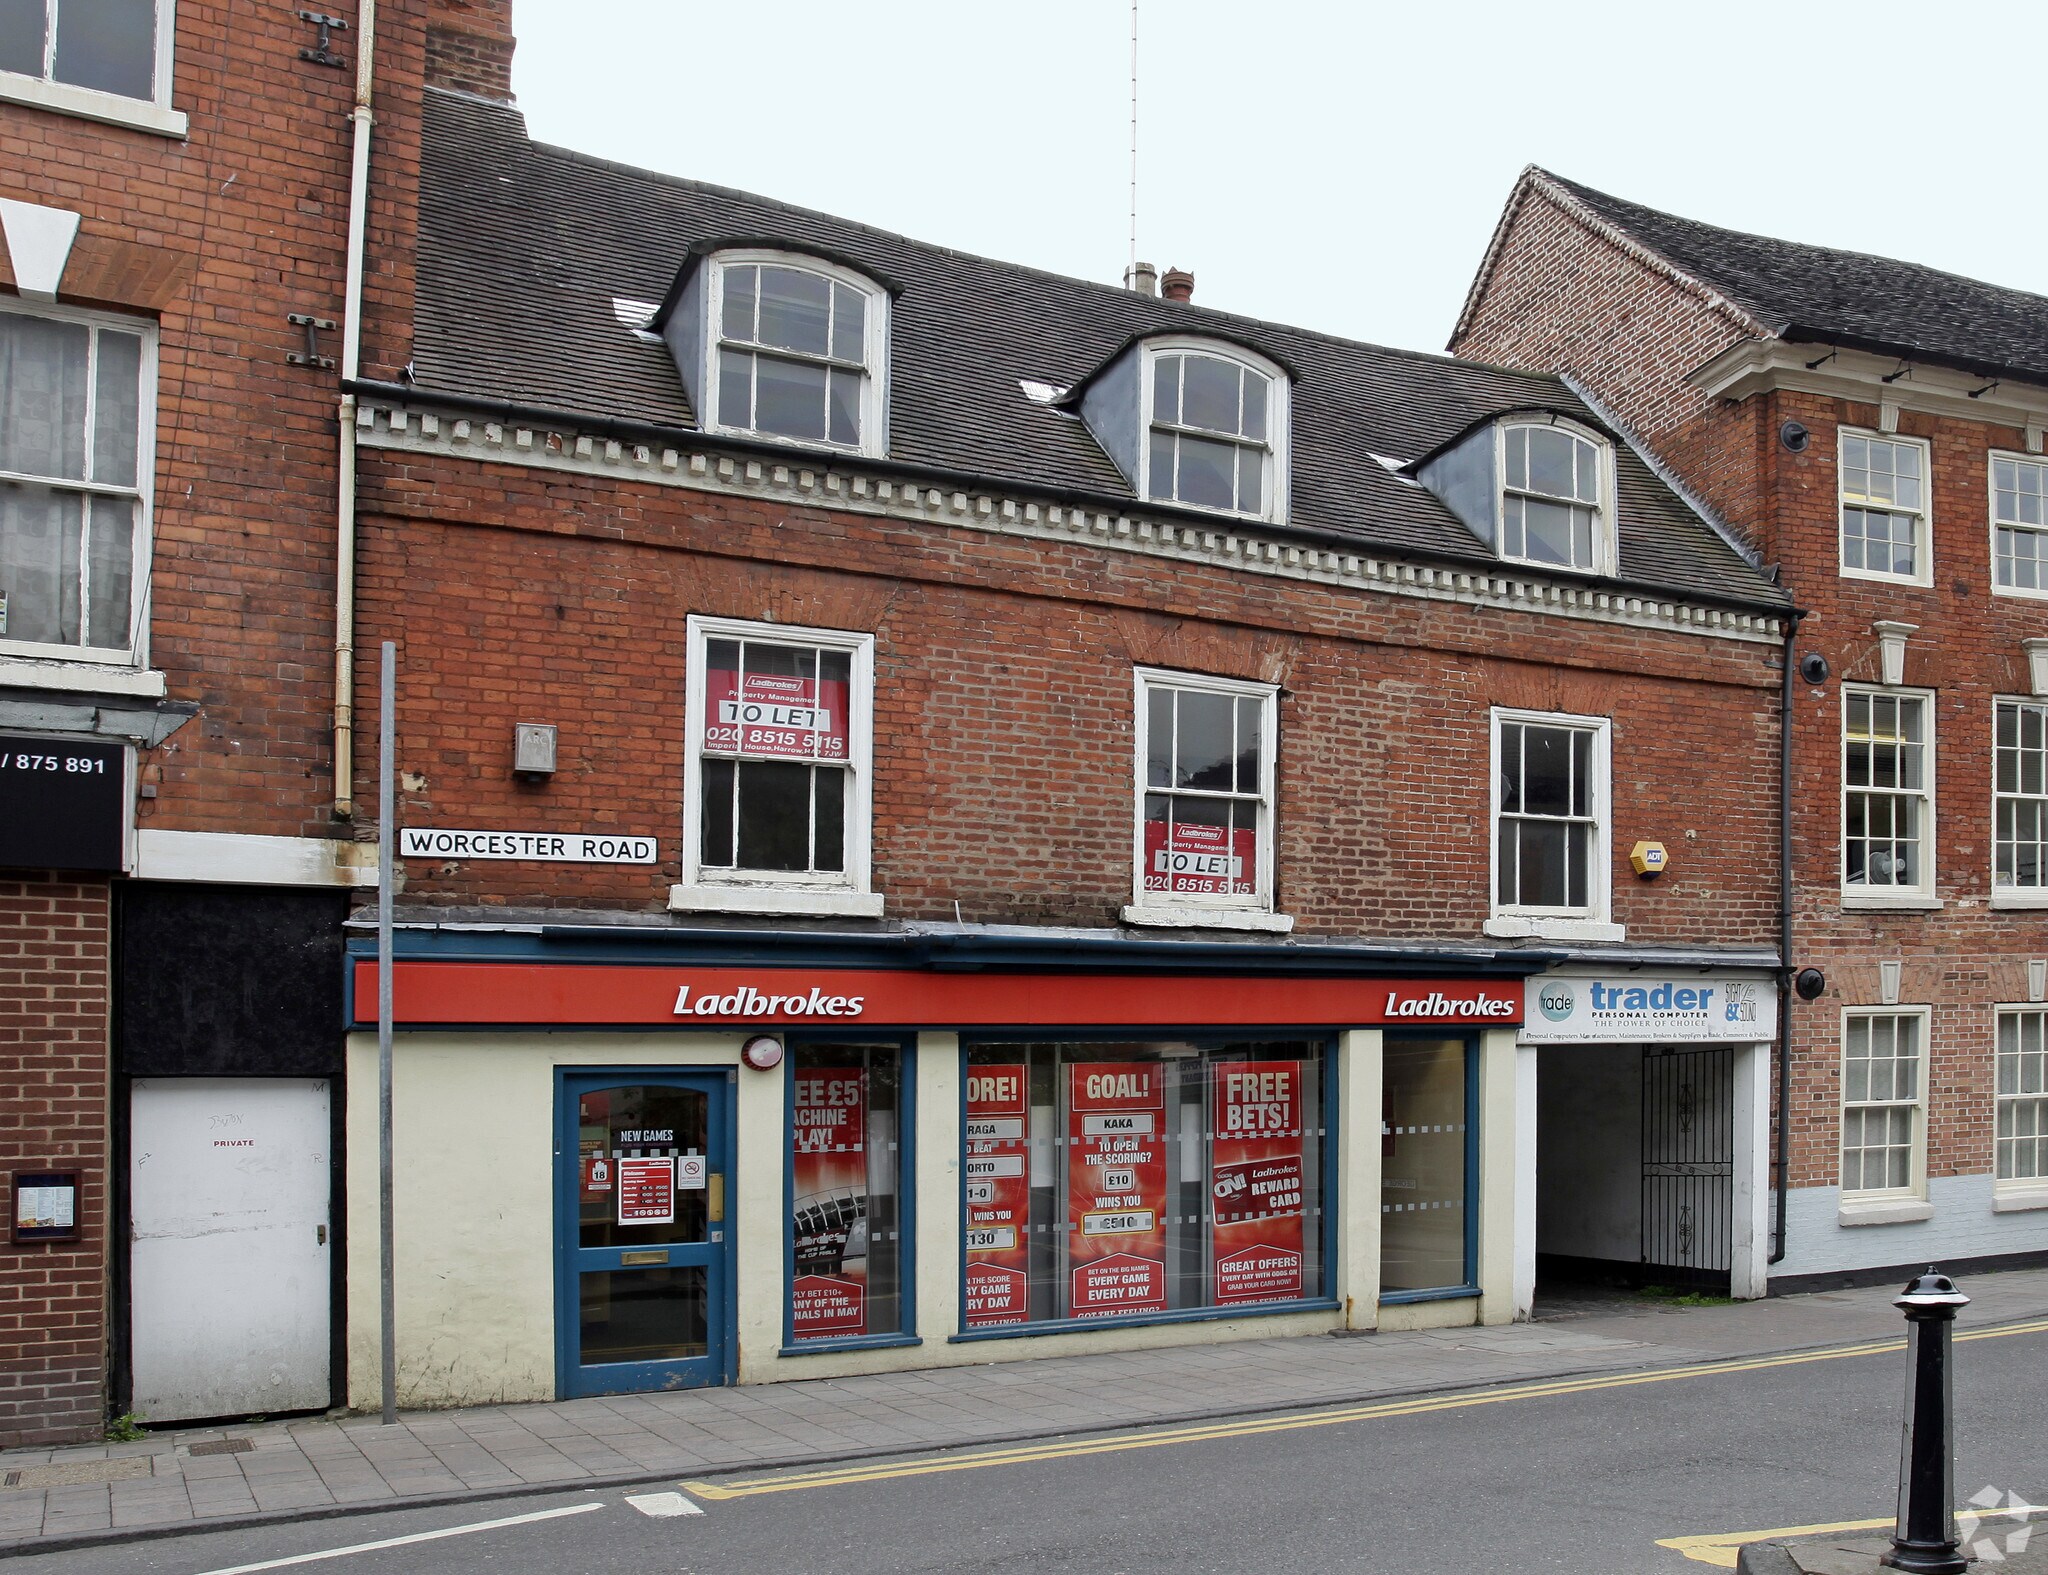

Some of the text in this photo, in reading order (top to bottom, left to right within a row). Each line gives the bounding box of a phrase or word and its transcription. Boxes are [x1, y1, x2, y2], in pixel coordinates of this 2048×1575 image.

[751, 679, 798, 690] Ladbrokes
[728, 690, 765, 700] Prperty
[728, 704, 822, 727] TO LET
[749, 729, 796, 746] 8515
[16, 754, 58, 771] 875
[65, 757, 104, 774] 891
[1181, 829, 1219, 839] Ladbrokes
[409, 832, 650, 860] WORCESTER ROAD
[1163, 839, 1193, 850] Poperty
[1647, 852, 1662, 861] ADT
[1162, 853, 1235, 874] TO LET
[1176, 878, 1213, 892] 8515
[1218, 881, 1250, 894] 515
[672, 985, 865, 1017] Ladbrokes
[1590, 982, 1714, 1010] trader
[1384, 992, 1515, 1016] Ladbrokes
[1725, 1003, 1741, 1022] &
[1654, 1020, 1668, 1028] OF
[967, 1077, 1017, 1102] ORE!
[1086, 1074, 1149, 1099] GOAL!
[1227, 1072, 1290, 1103] FREE
[795, 1080, 859, 1107] EE £5
[1227, 1102, 1289, 1130] BETS!
[967, 1125, 996, 1135] RAGA
[1104, 1119, 1133, 1128] KAKA
[621, 1129, 673, 1142] NEW GAMES
[973, 1143, 992, 1153] BEAT
[1099, 1140, 1138, 1152] TO OPEN
[1085, 1152, 1152, 1165] THE SCORING?
[967, 1162, 995, 1173] ORTO
[1252, 1165, 1297, 1178] Ladbrokes
[594, 1171, 605, 1179] 18
[1108, 1175, 1129, 1185] £10
[1214, 1173, 1248, 1198] ON!
[1251, 1177, 1300, 1196] REWARD
[968, 1188, 987, 1198] 1-0
[1095, 1195, 1141, 1208] WINS YOU
[1269, 1192, 1301, 1208] CARD
[974, 1210, 1012, 1221] WINS YOU
[1222, 1256, 1298, 1273] GREAT OFFERS
[987, 1275, 1011, 1283] SCORE
[1088, 1273, 1150, 1286] EVERY GAME
[1222, 1274, 1241, 1282] EVERY
[1255, 1271, 1271, 1279] WITH
[980, 1284, 1011, 1295] GAME
[1227, 1282, 1243, 1291] GRAB
[1244, 1281, 1260, 1289] YOUR
[1261, 1280, 1276, 1288] CARD
[807, 1289, 821, 1297] BET
[823, 1288, 843, 1297] £10+
[1088, 1285, 1150, 1301] EVERY DAY
[814, 1298, 828, 1308] OF
[830, 1297, 849, 1306] THE
[987, 1296, 1011, 1309] DAY
[794, 1306, 859, 1320] NALS IN MAY
